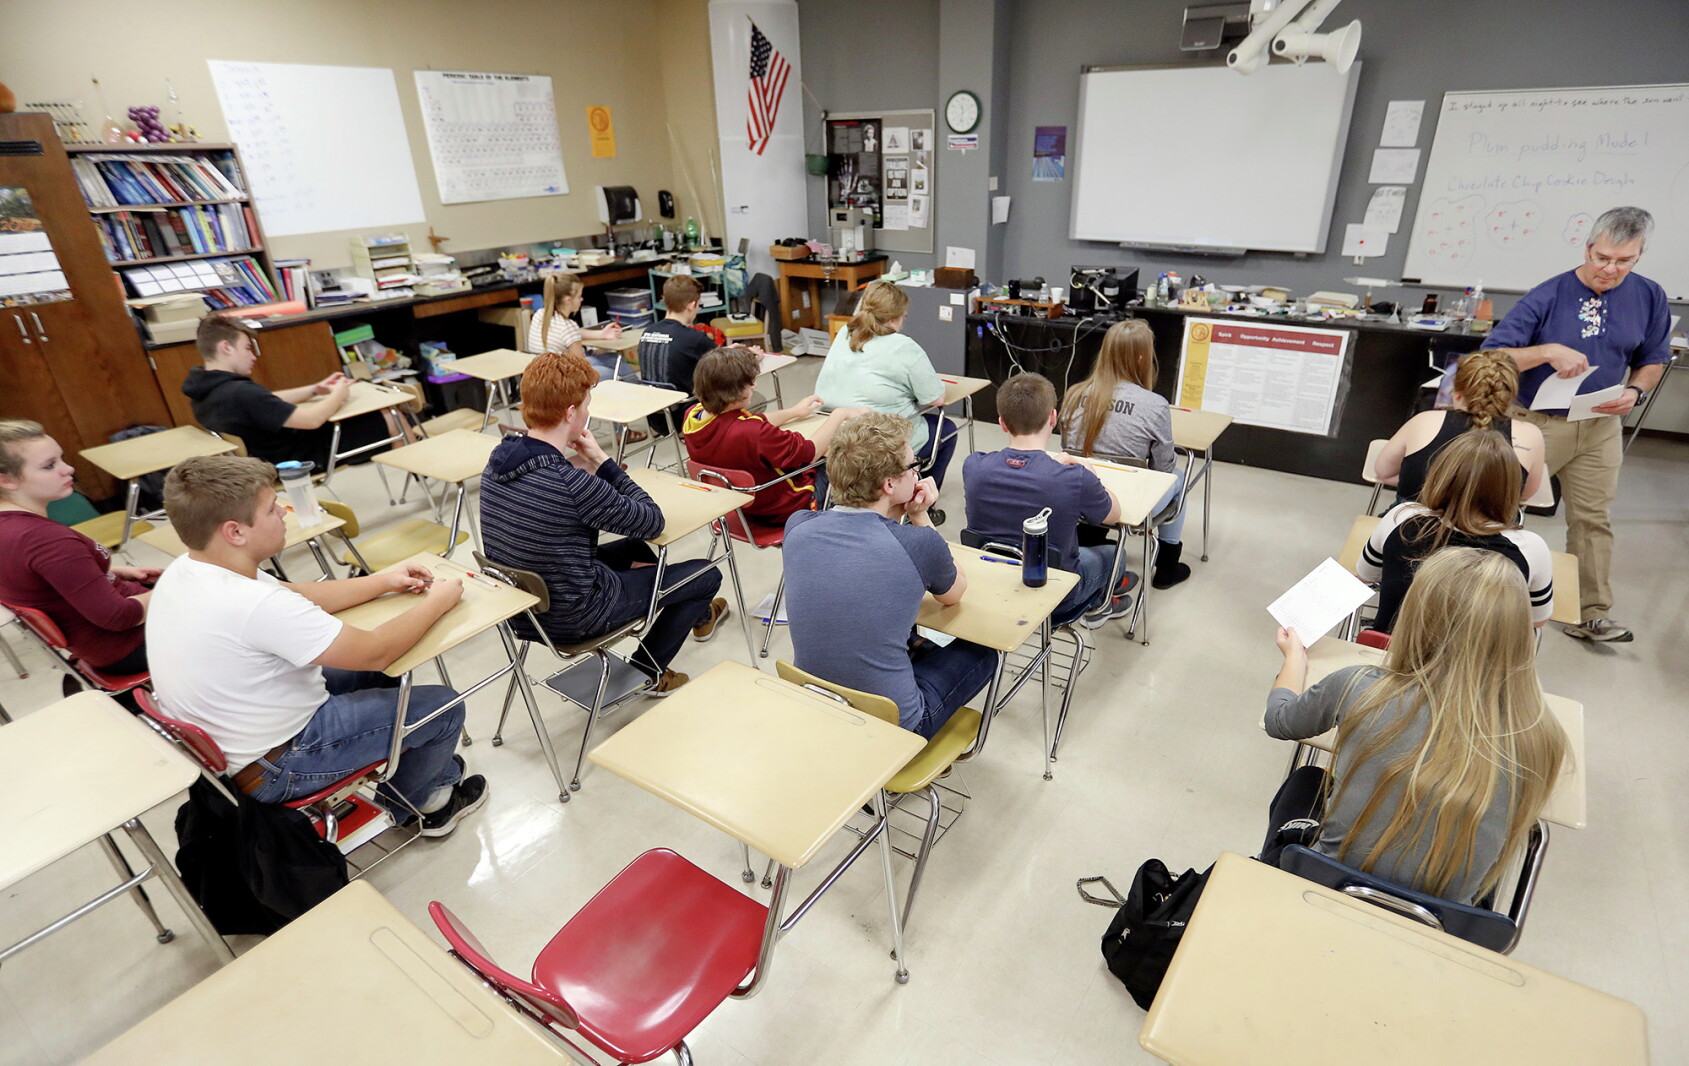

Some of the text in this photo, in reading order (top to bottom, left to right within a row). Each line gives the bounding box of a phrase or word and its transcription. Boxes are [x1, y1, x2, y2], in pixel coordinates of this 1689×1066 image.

[1468, 131, 1649, 163] Plum pudding Model
[1447, 174, 1507, 192] Chocolate
[1512, 174, 1542, 193] Chip
[1546, 173, 1588, 187] Cookie
[1240, 334, 1270, 342] Opportunity
[1272, 337, 1305, 345] Achievement
